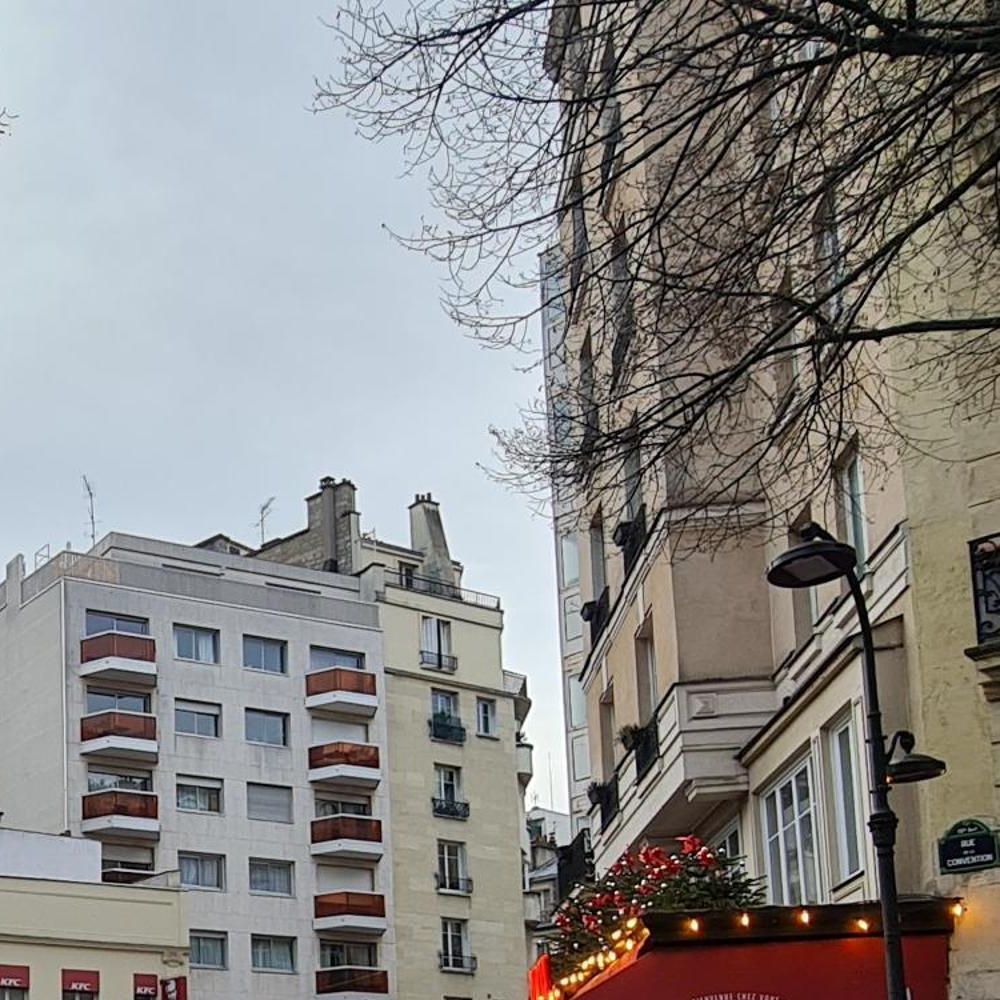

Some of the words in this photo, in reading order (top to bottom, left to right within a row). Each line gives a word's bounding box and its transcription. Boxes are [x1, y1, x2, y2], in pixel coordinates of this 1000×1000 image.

[0, 978, 23, 987] KFC
[71, 982, 93, 991] KFC
[136, 986, 156, 995] KFC
[736, 992, 756, 1000] CHEZ
